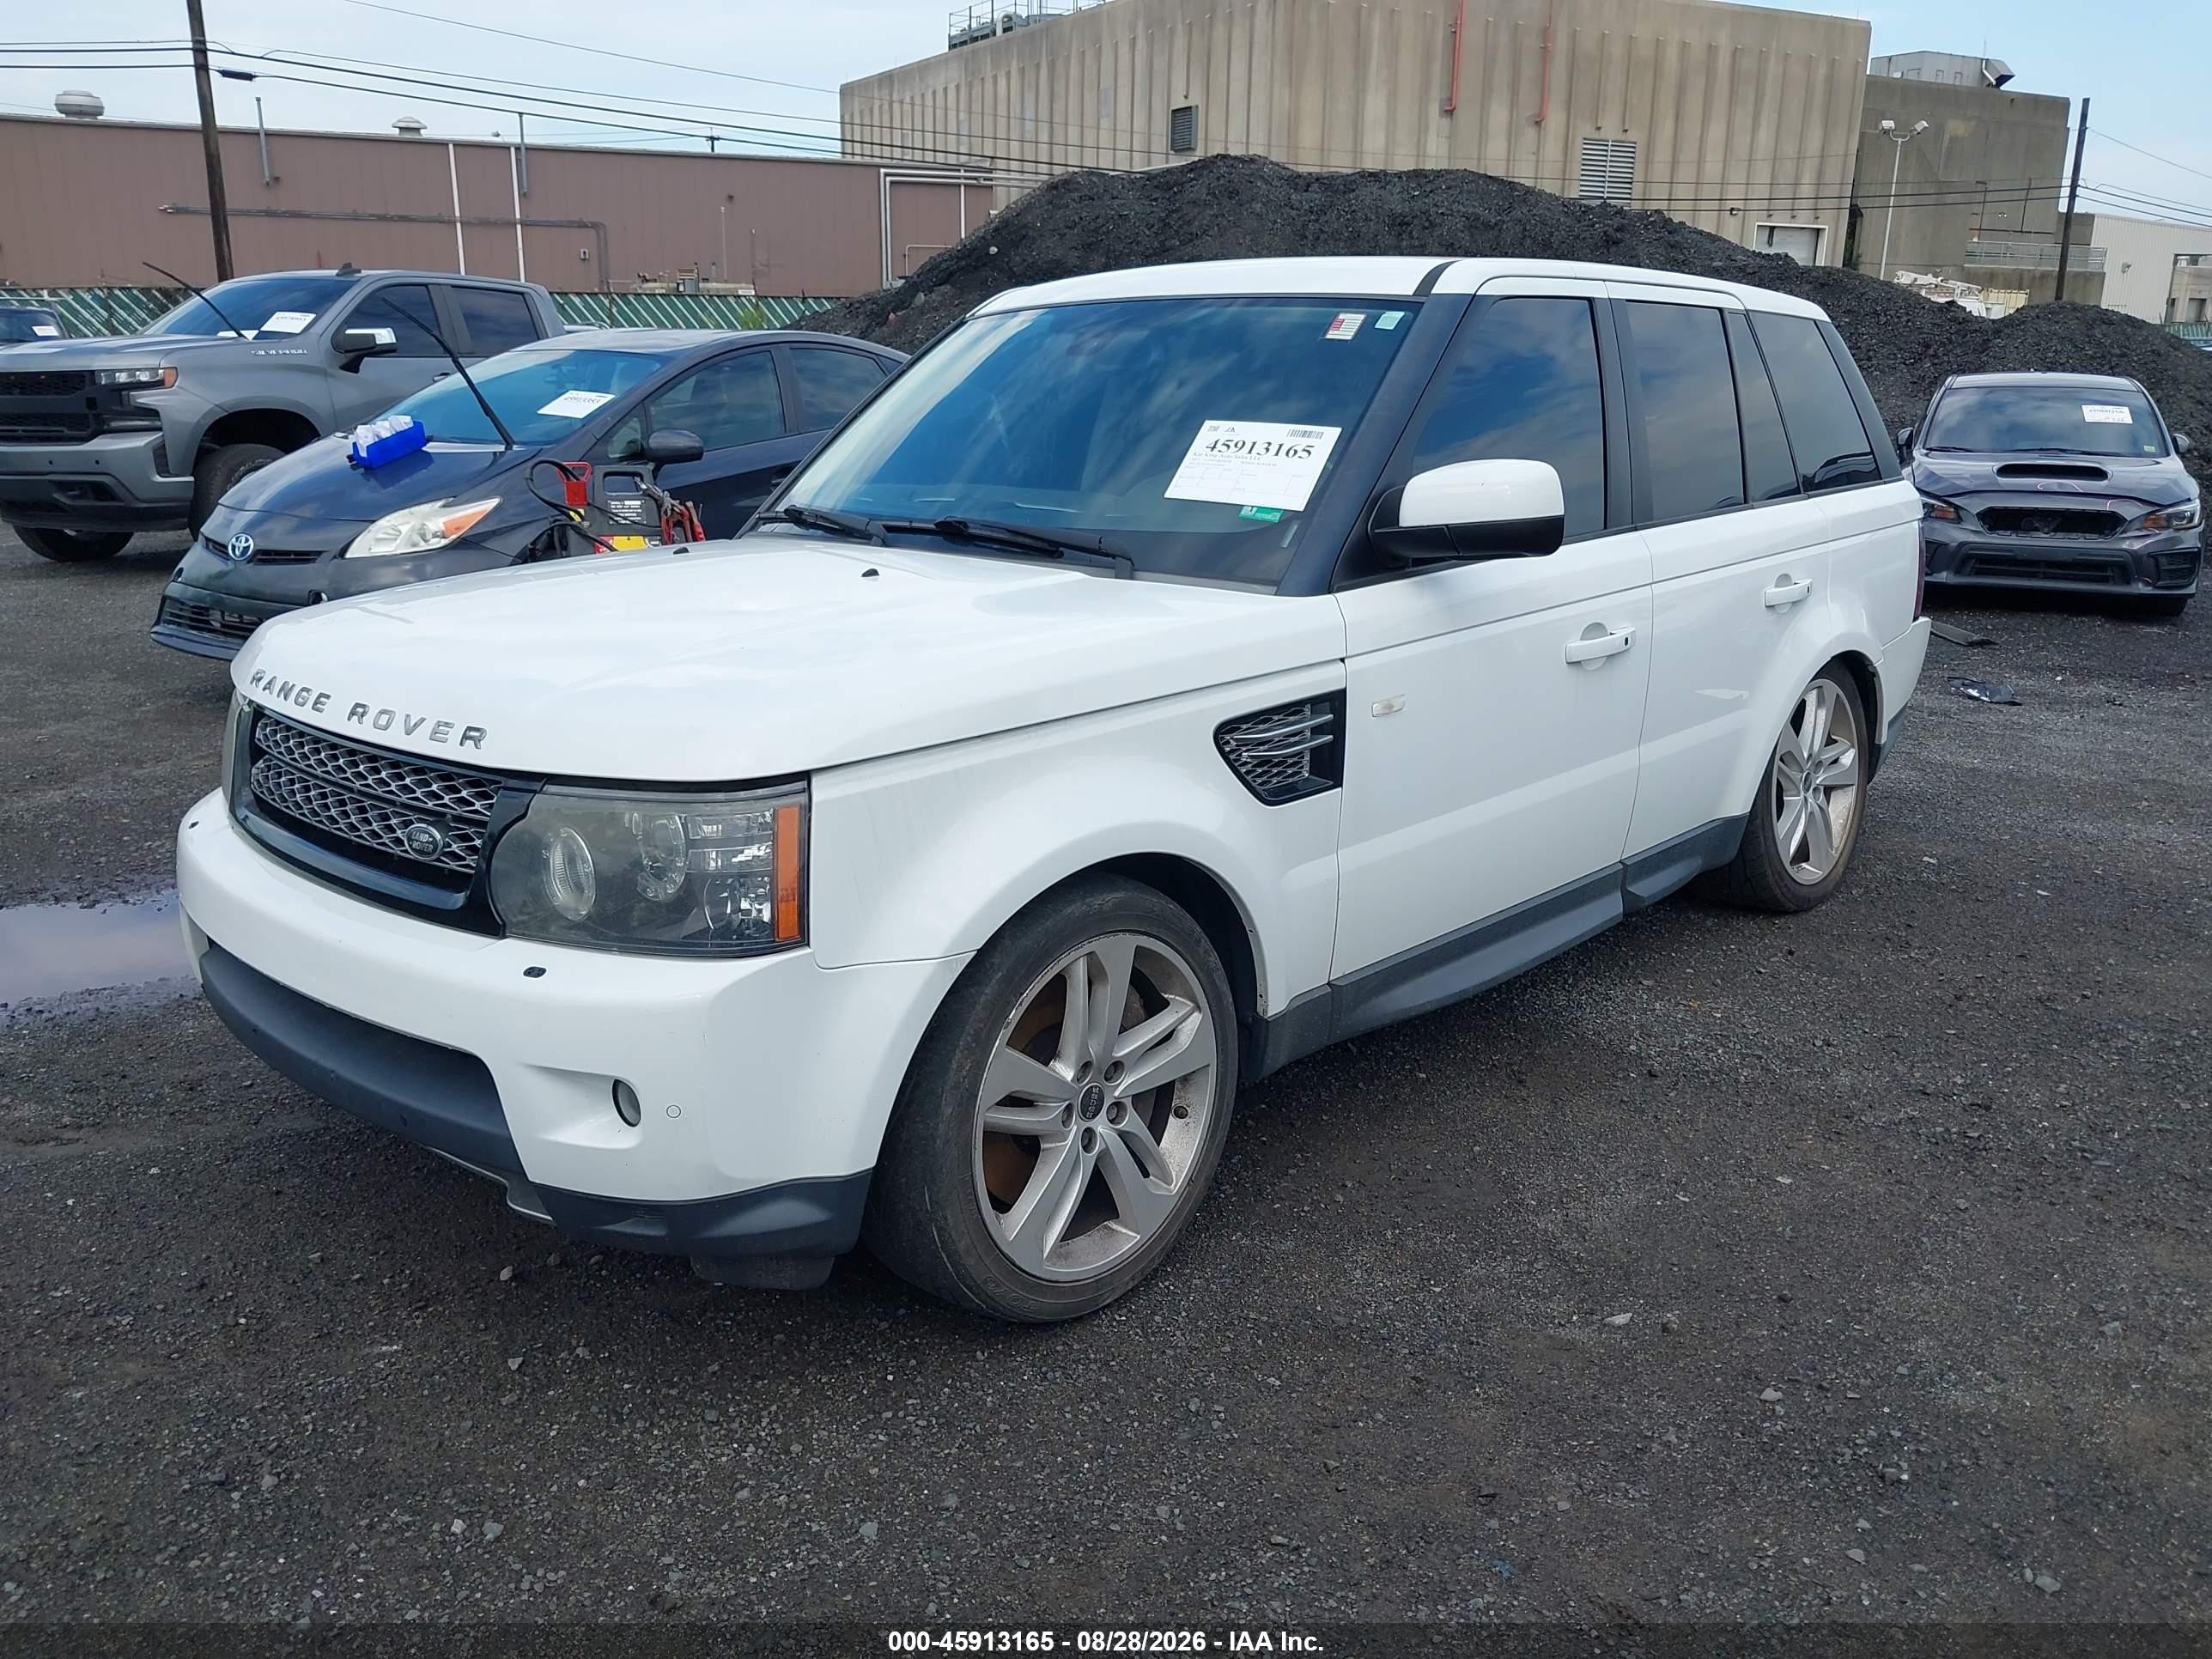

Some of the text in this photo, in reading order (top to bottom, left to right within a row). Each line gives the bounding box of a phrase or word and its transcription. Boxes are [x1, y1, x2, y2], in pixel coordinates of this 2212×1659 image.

[1206, 439, 1316, 459] 45913165
[250, 669, 488, 750] RANGE ROVER
[411, 831, 429, 842] LAND
[412, 841, 434, 853] ROVER
